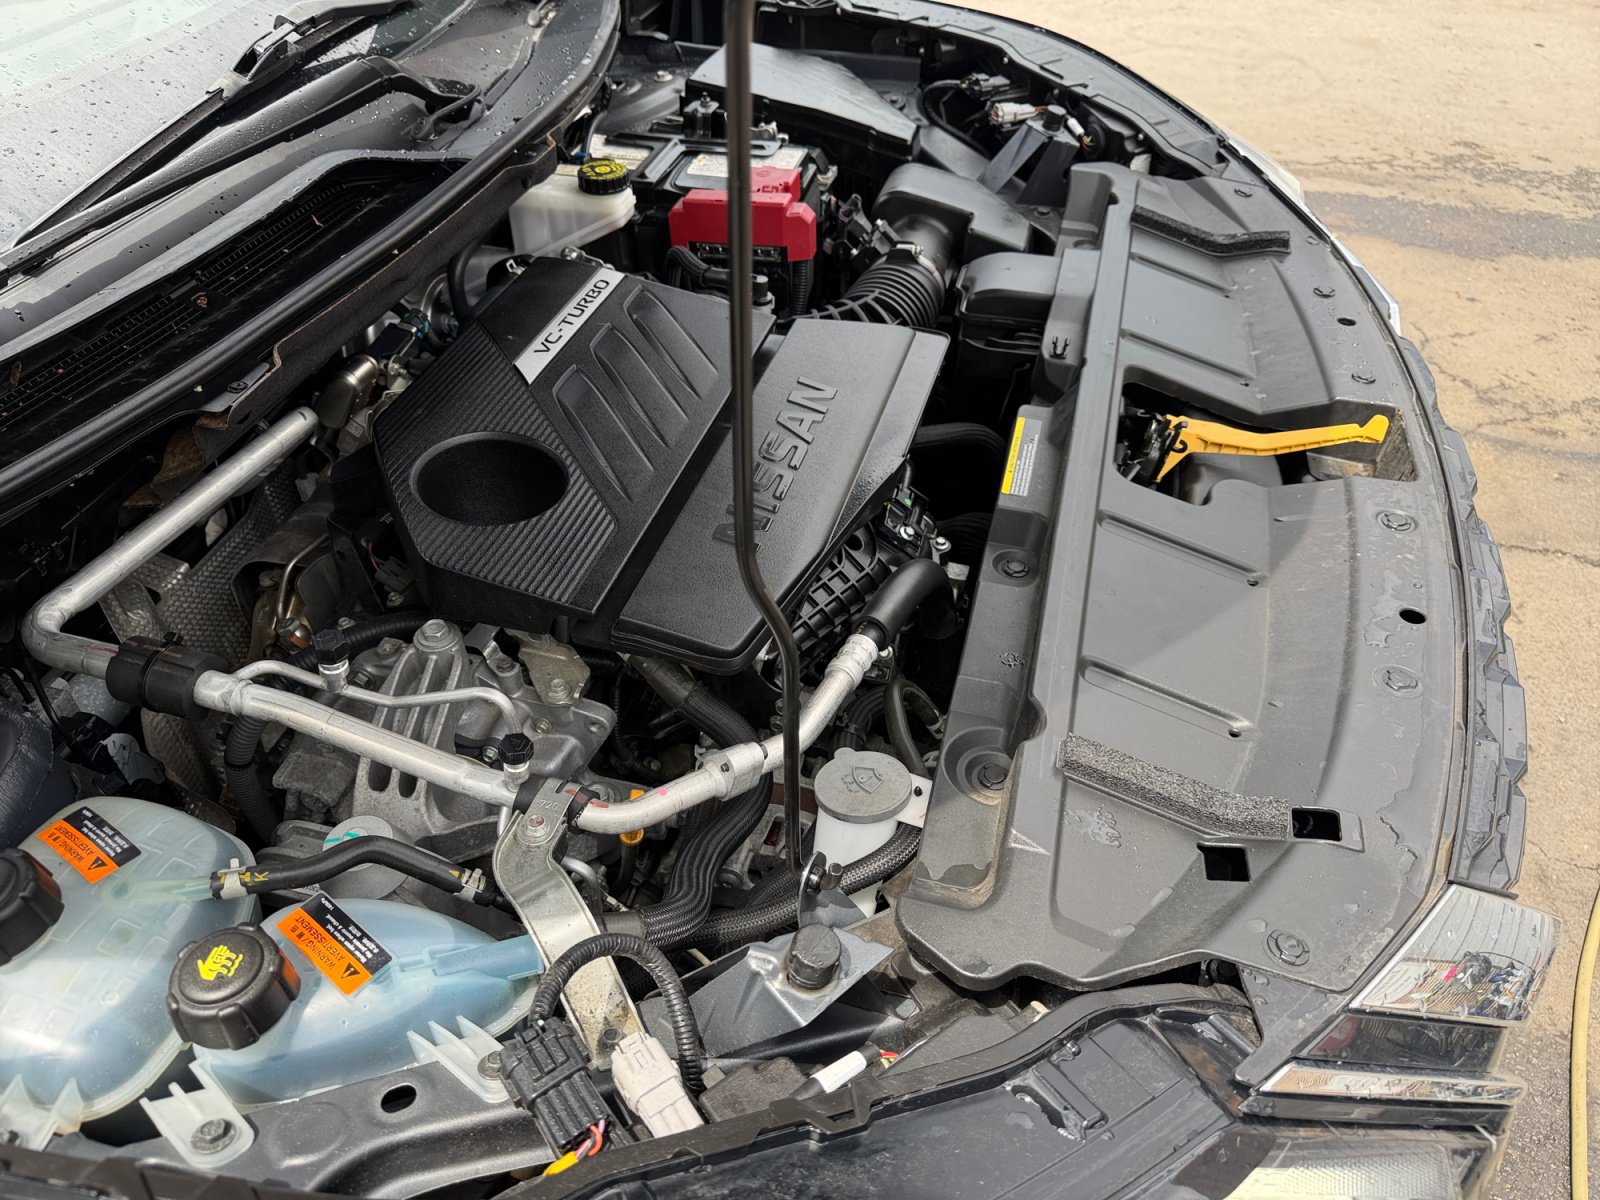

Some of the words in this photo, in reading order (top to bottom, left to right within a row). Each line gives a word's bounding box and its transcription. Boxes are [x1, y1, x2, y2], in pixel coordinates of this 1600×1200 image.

[533, 279, 610, 354] VC-TURBO
[54, 824, 95, 856] AVERTISSEMENT
[58, 840, 85, 863] WARNING
[295, 915, 346, 961] AVERTISSEMENT
[305, 940, 336, 970] WARNING
